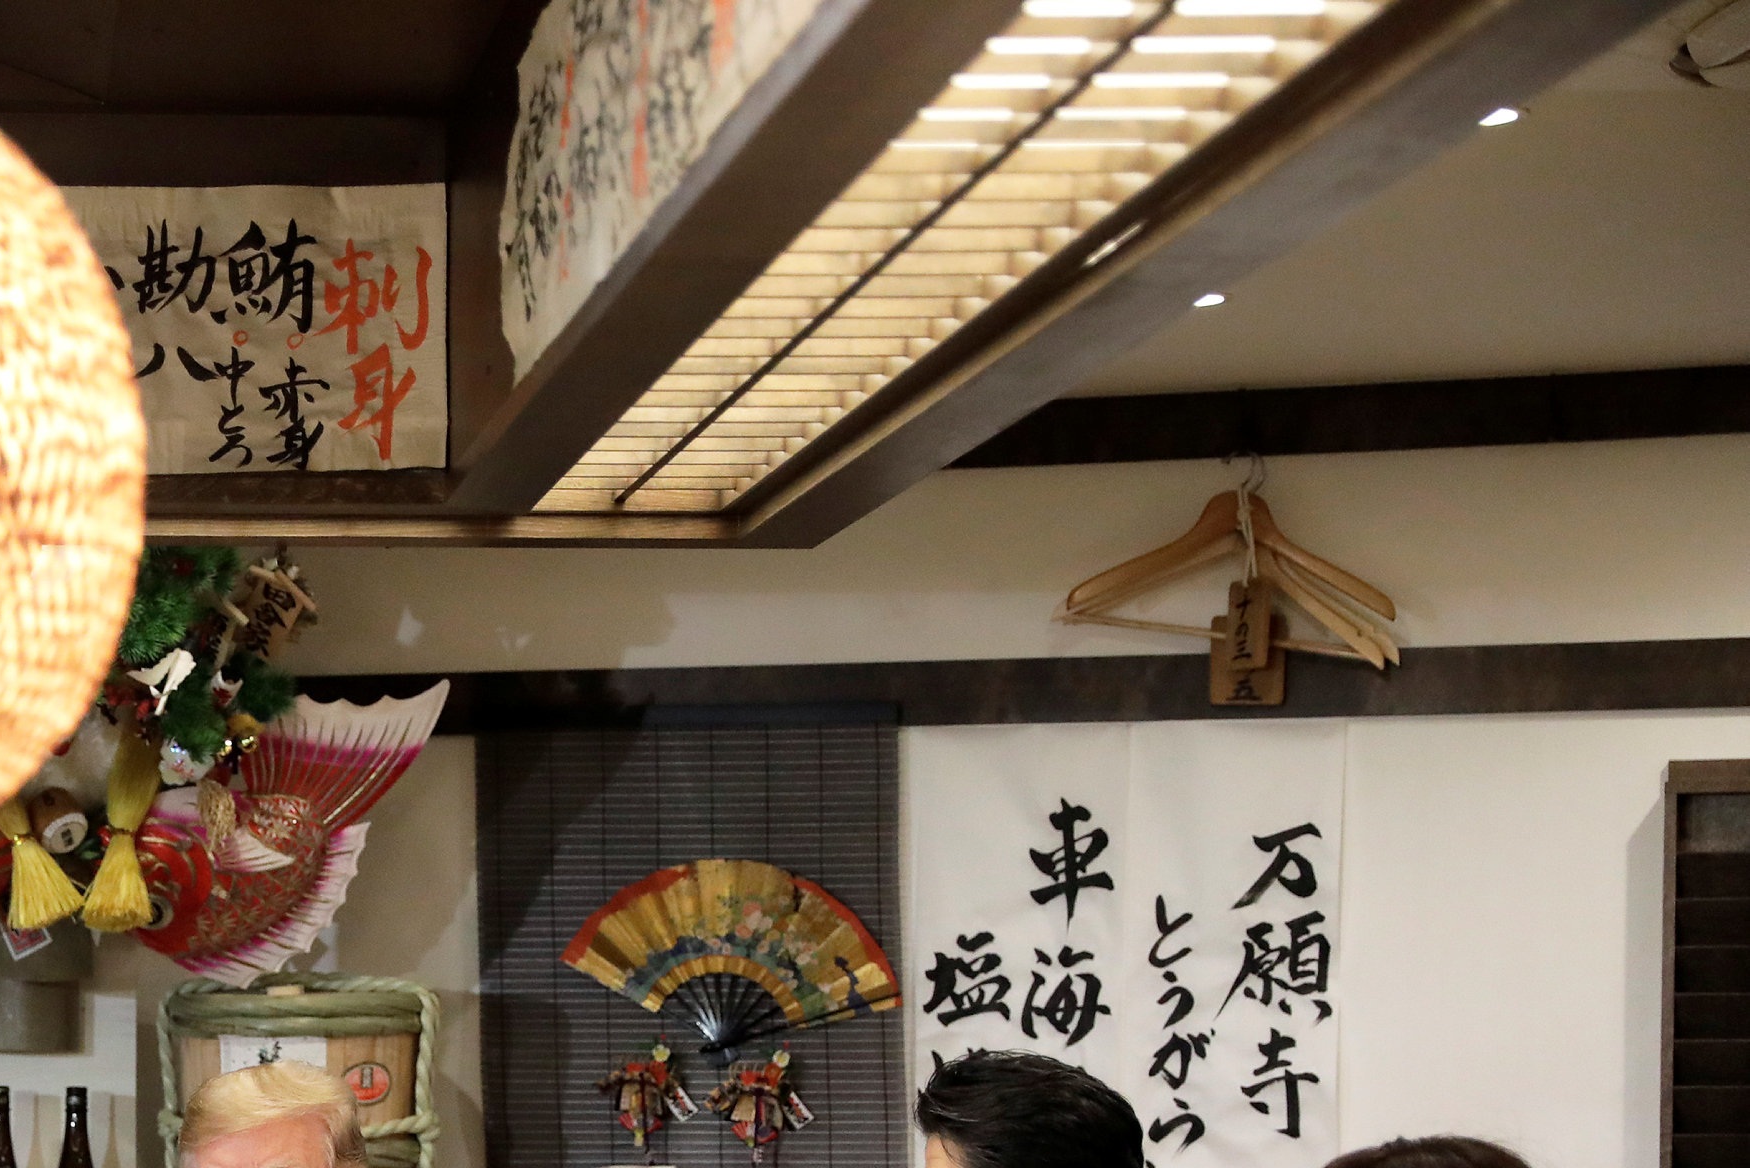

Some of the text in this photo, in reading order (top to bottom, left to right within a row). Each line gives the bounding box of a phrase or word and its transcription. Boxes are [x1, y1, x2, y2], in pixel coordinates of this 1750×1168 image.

[210, 218, 317, 334] 鮪
[209, 346, 255, 467] 中とろ
[311, 238, 432, 460] 刺身
[258, 357, 330, 470] 赤身
[1020, 797, 1114, 1050] 車海
[1216, 822, 1333, 1139] 万願寺
[923, 931, 1012, 1050] 塩
